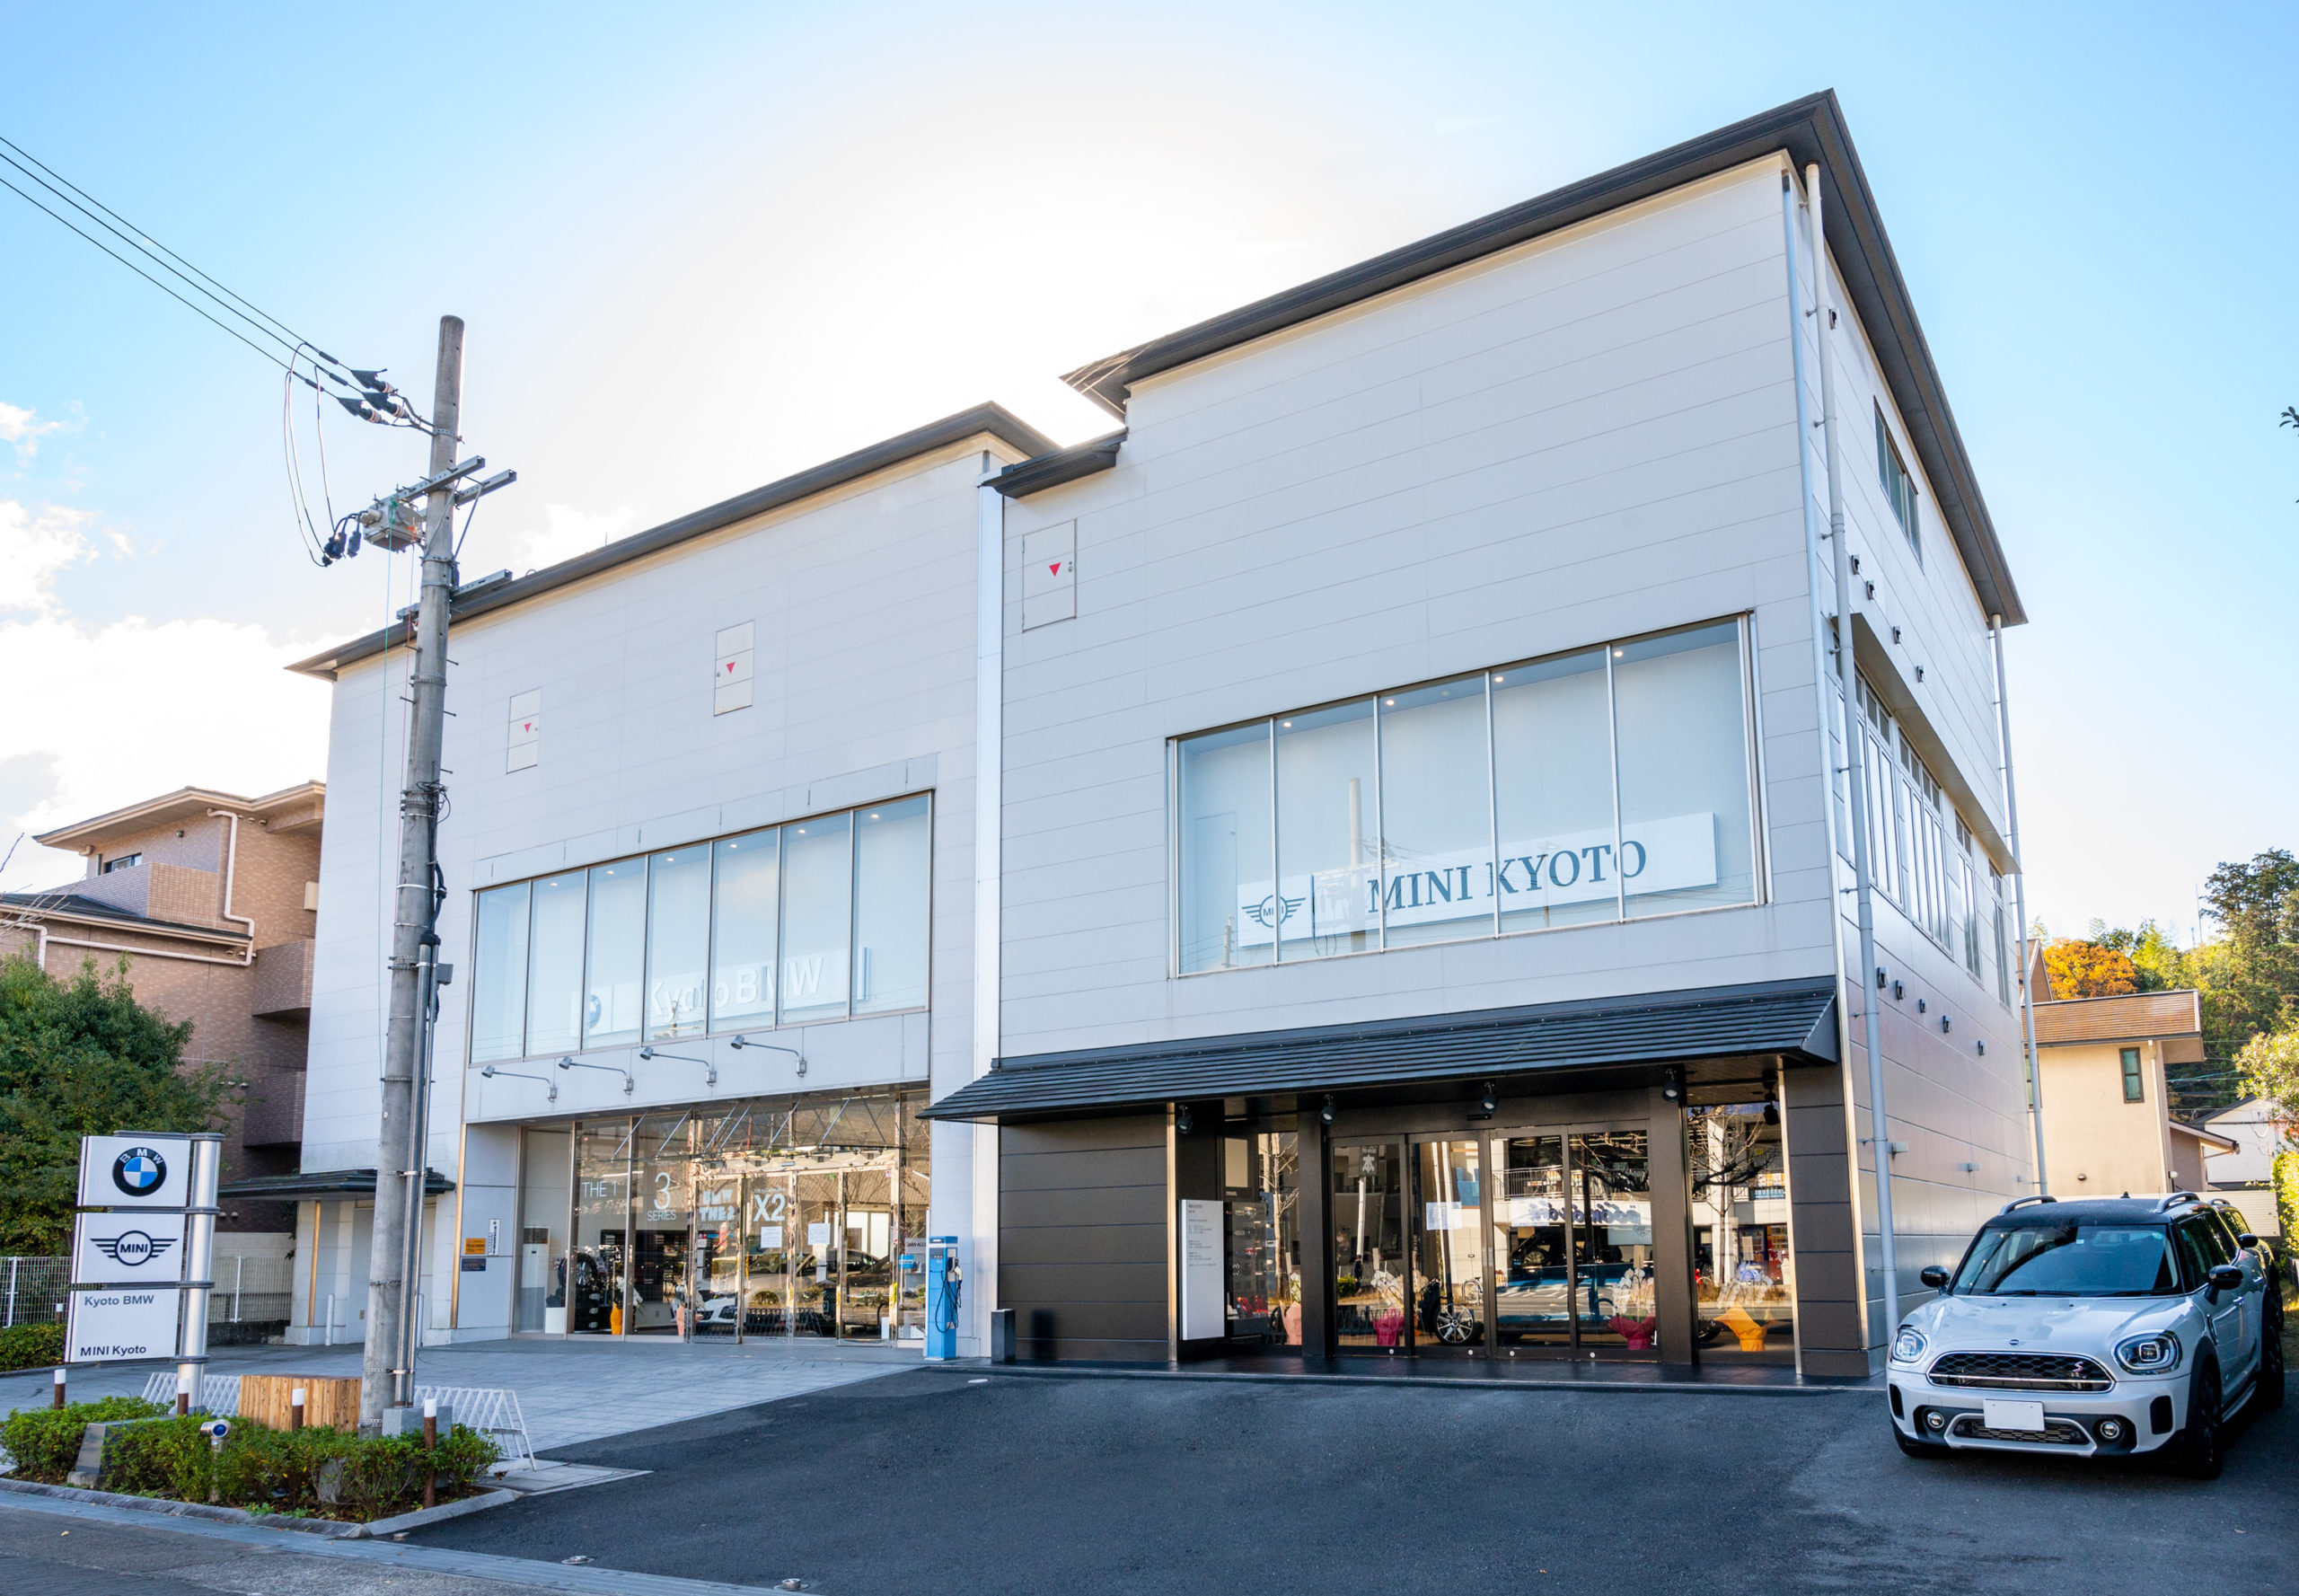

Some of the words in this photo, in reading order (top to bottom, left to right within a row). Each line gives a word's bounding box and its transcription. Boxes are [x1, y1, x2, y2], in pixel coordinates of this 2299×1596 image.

[1368, 864, 1474, 913] MINI
[1486, 840, 1647, 897] KYOTO
[1263, 905, 1284, 917] MII
[119, 1149, 163, 1165] BMW
[582, 1180, 607, 1198] THE
[612, 1180, 618, 1196] 1
[654, 1171, 671, 1210] 3
[647, 1209, 677, 1221] SERIES
[753, 1194, 787, 1222] X2
[119, 1243, 148, 1254] MINI
[84, 1296, 119, 1309] Kyoto
[123, 1294, 154, 1306] BMW
[80, 1345, 110, 1357] MINI
[112, 1345, 147, 1357] Kyoto
